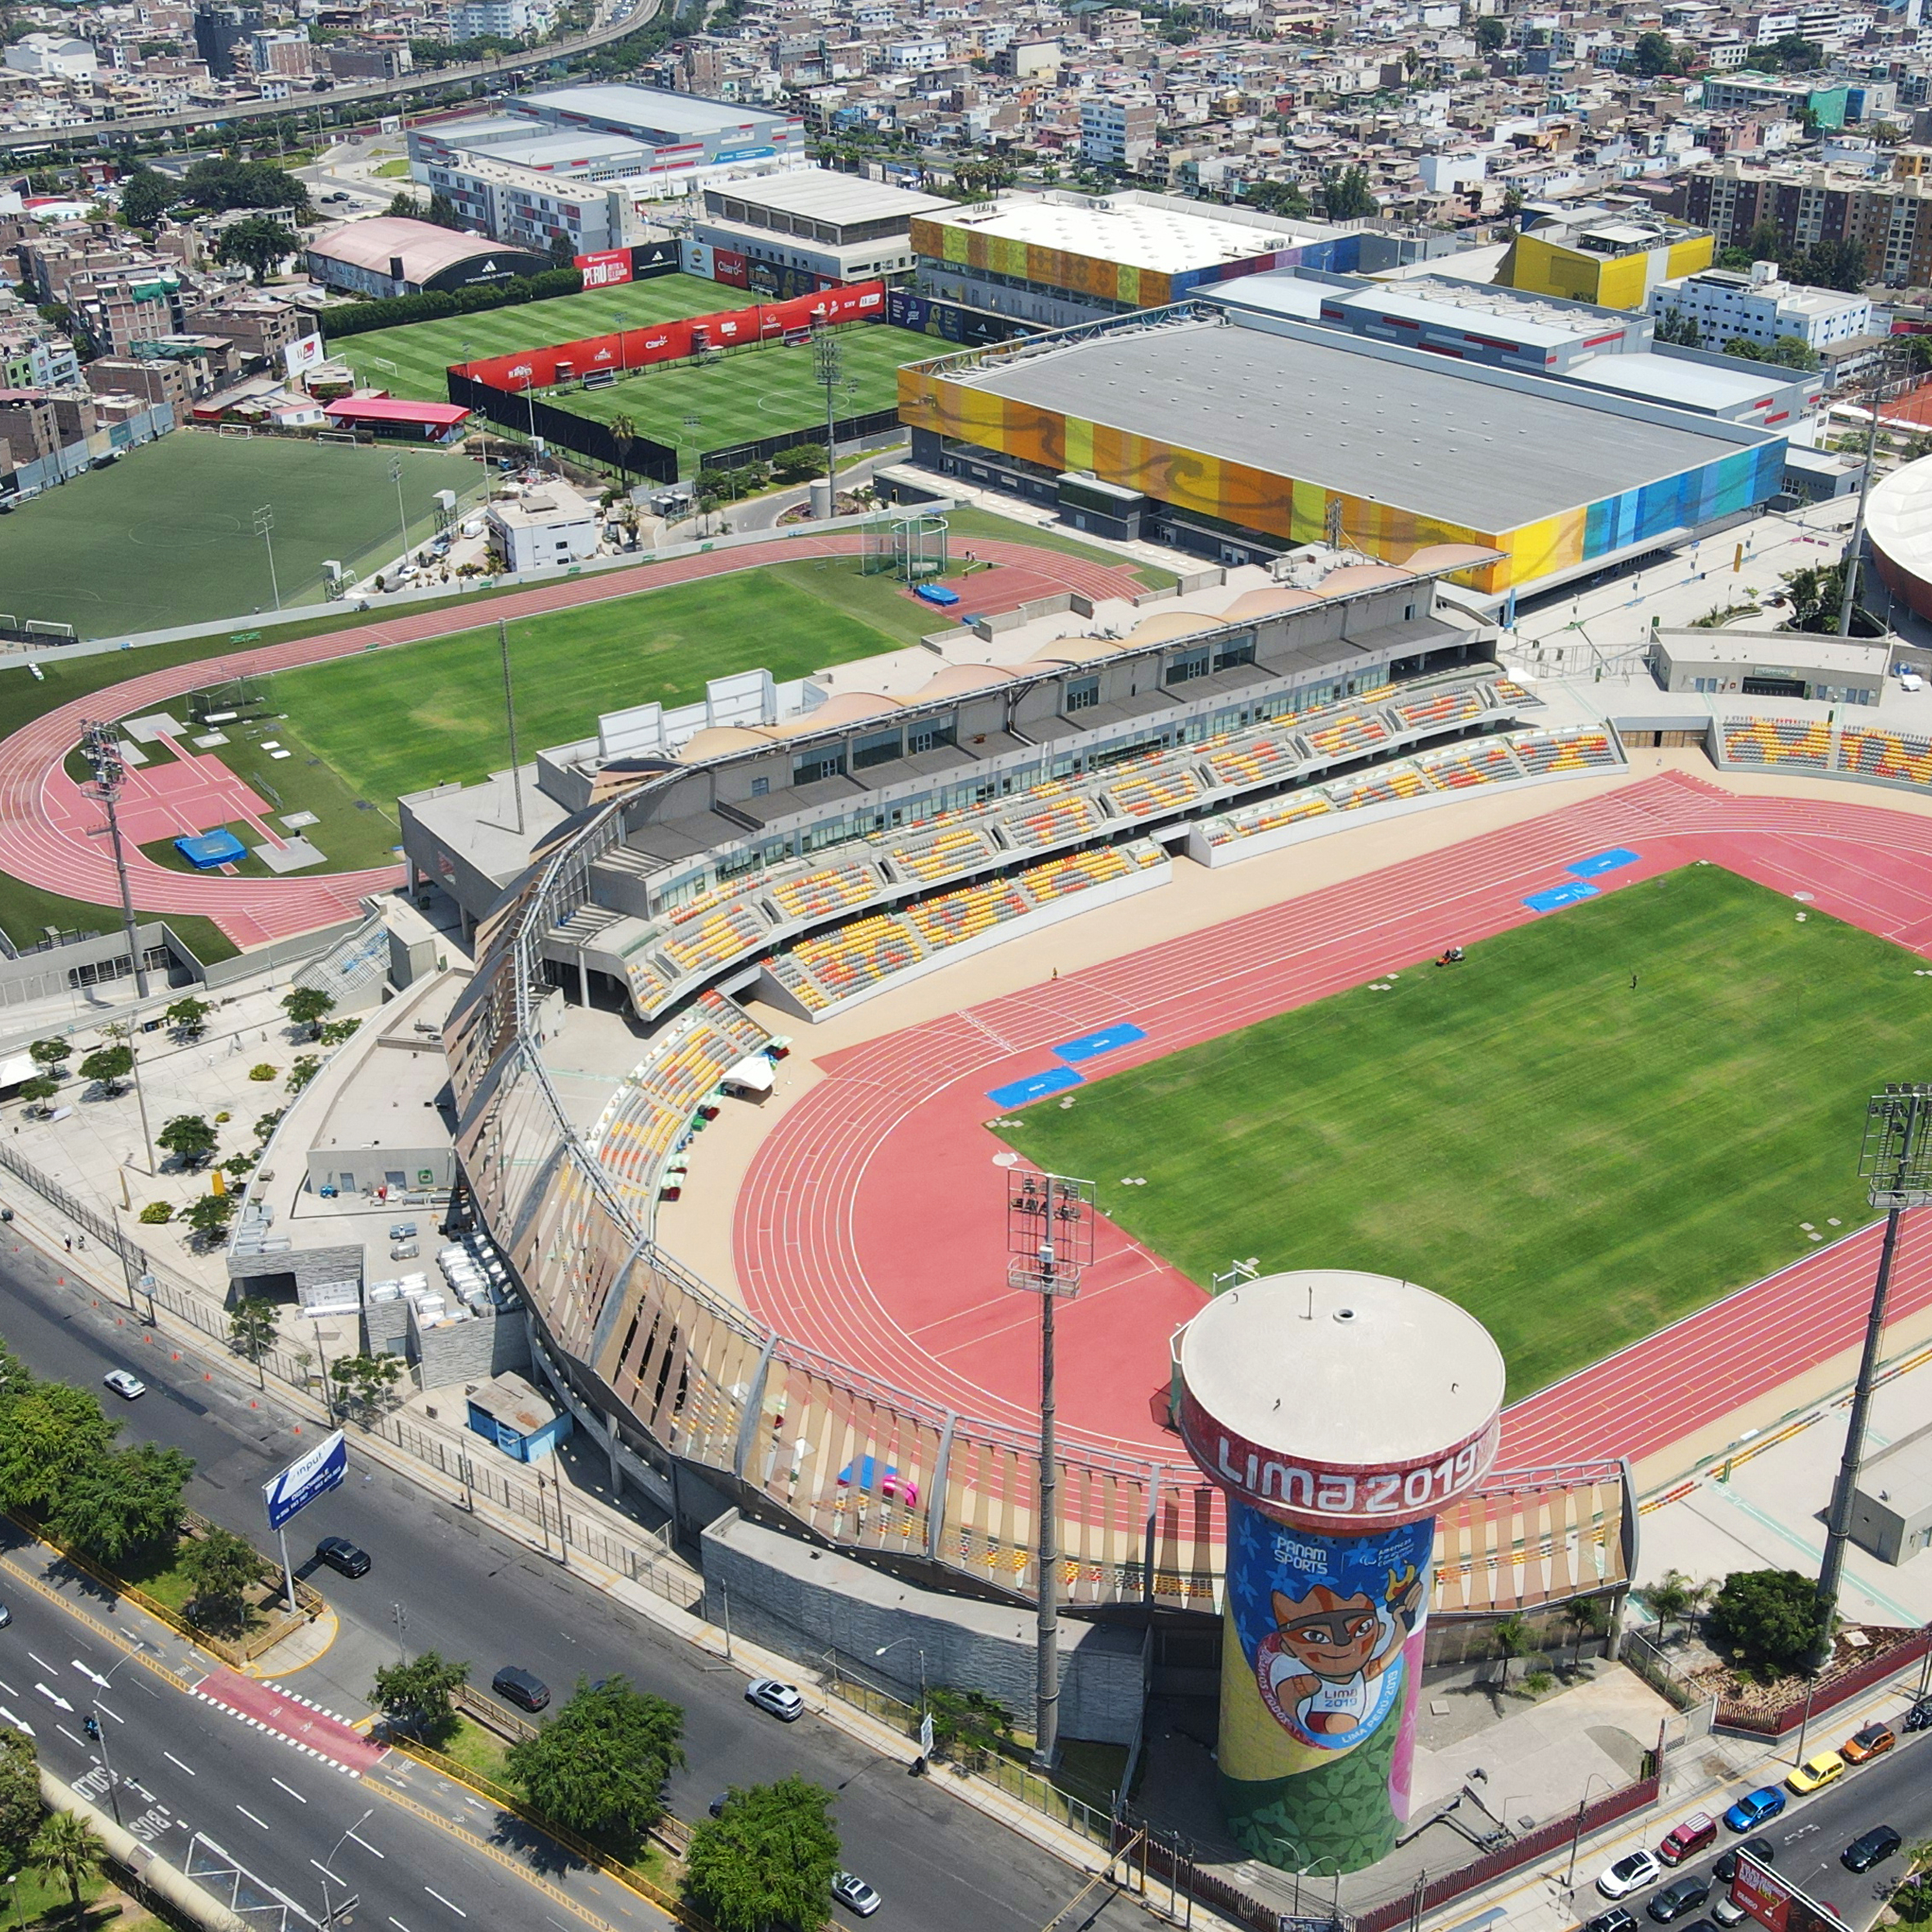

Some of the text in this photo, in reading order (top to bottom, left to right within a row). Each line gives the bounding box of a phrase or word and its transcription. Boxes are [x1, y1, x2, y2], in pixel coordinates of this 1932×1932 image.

[583, 262, 606, 285] PERÚ
[1365, 1441, 1479, 1513] 2019
[1277, 1535, 1327, 1562] PANAM
[1274, 1549, 1328, 1575] SPORTS
[1324, 1698, 1357, 1708] 2019
[1341, 1728, 1368, 1744] LIMA
[71, 1766, 119, 1801] SOLO
[128, 1809, 173, 1841] BUS
